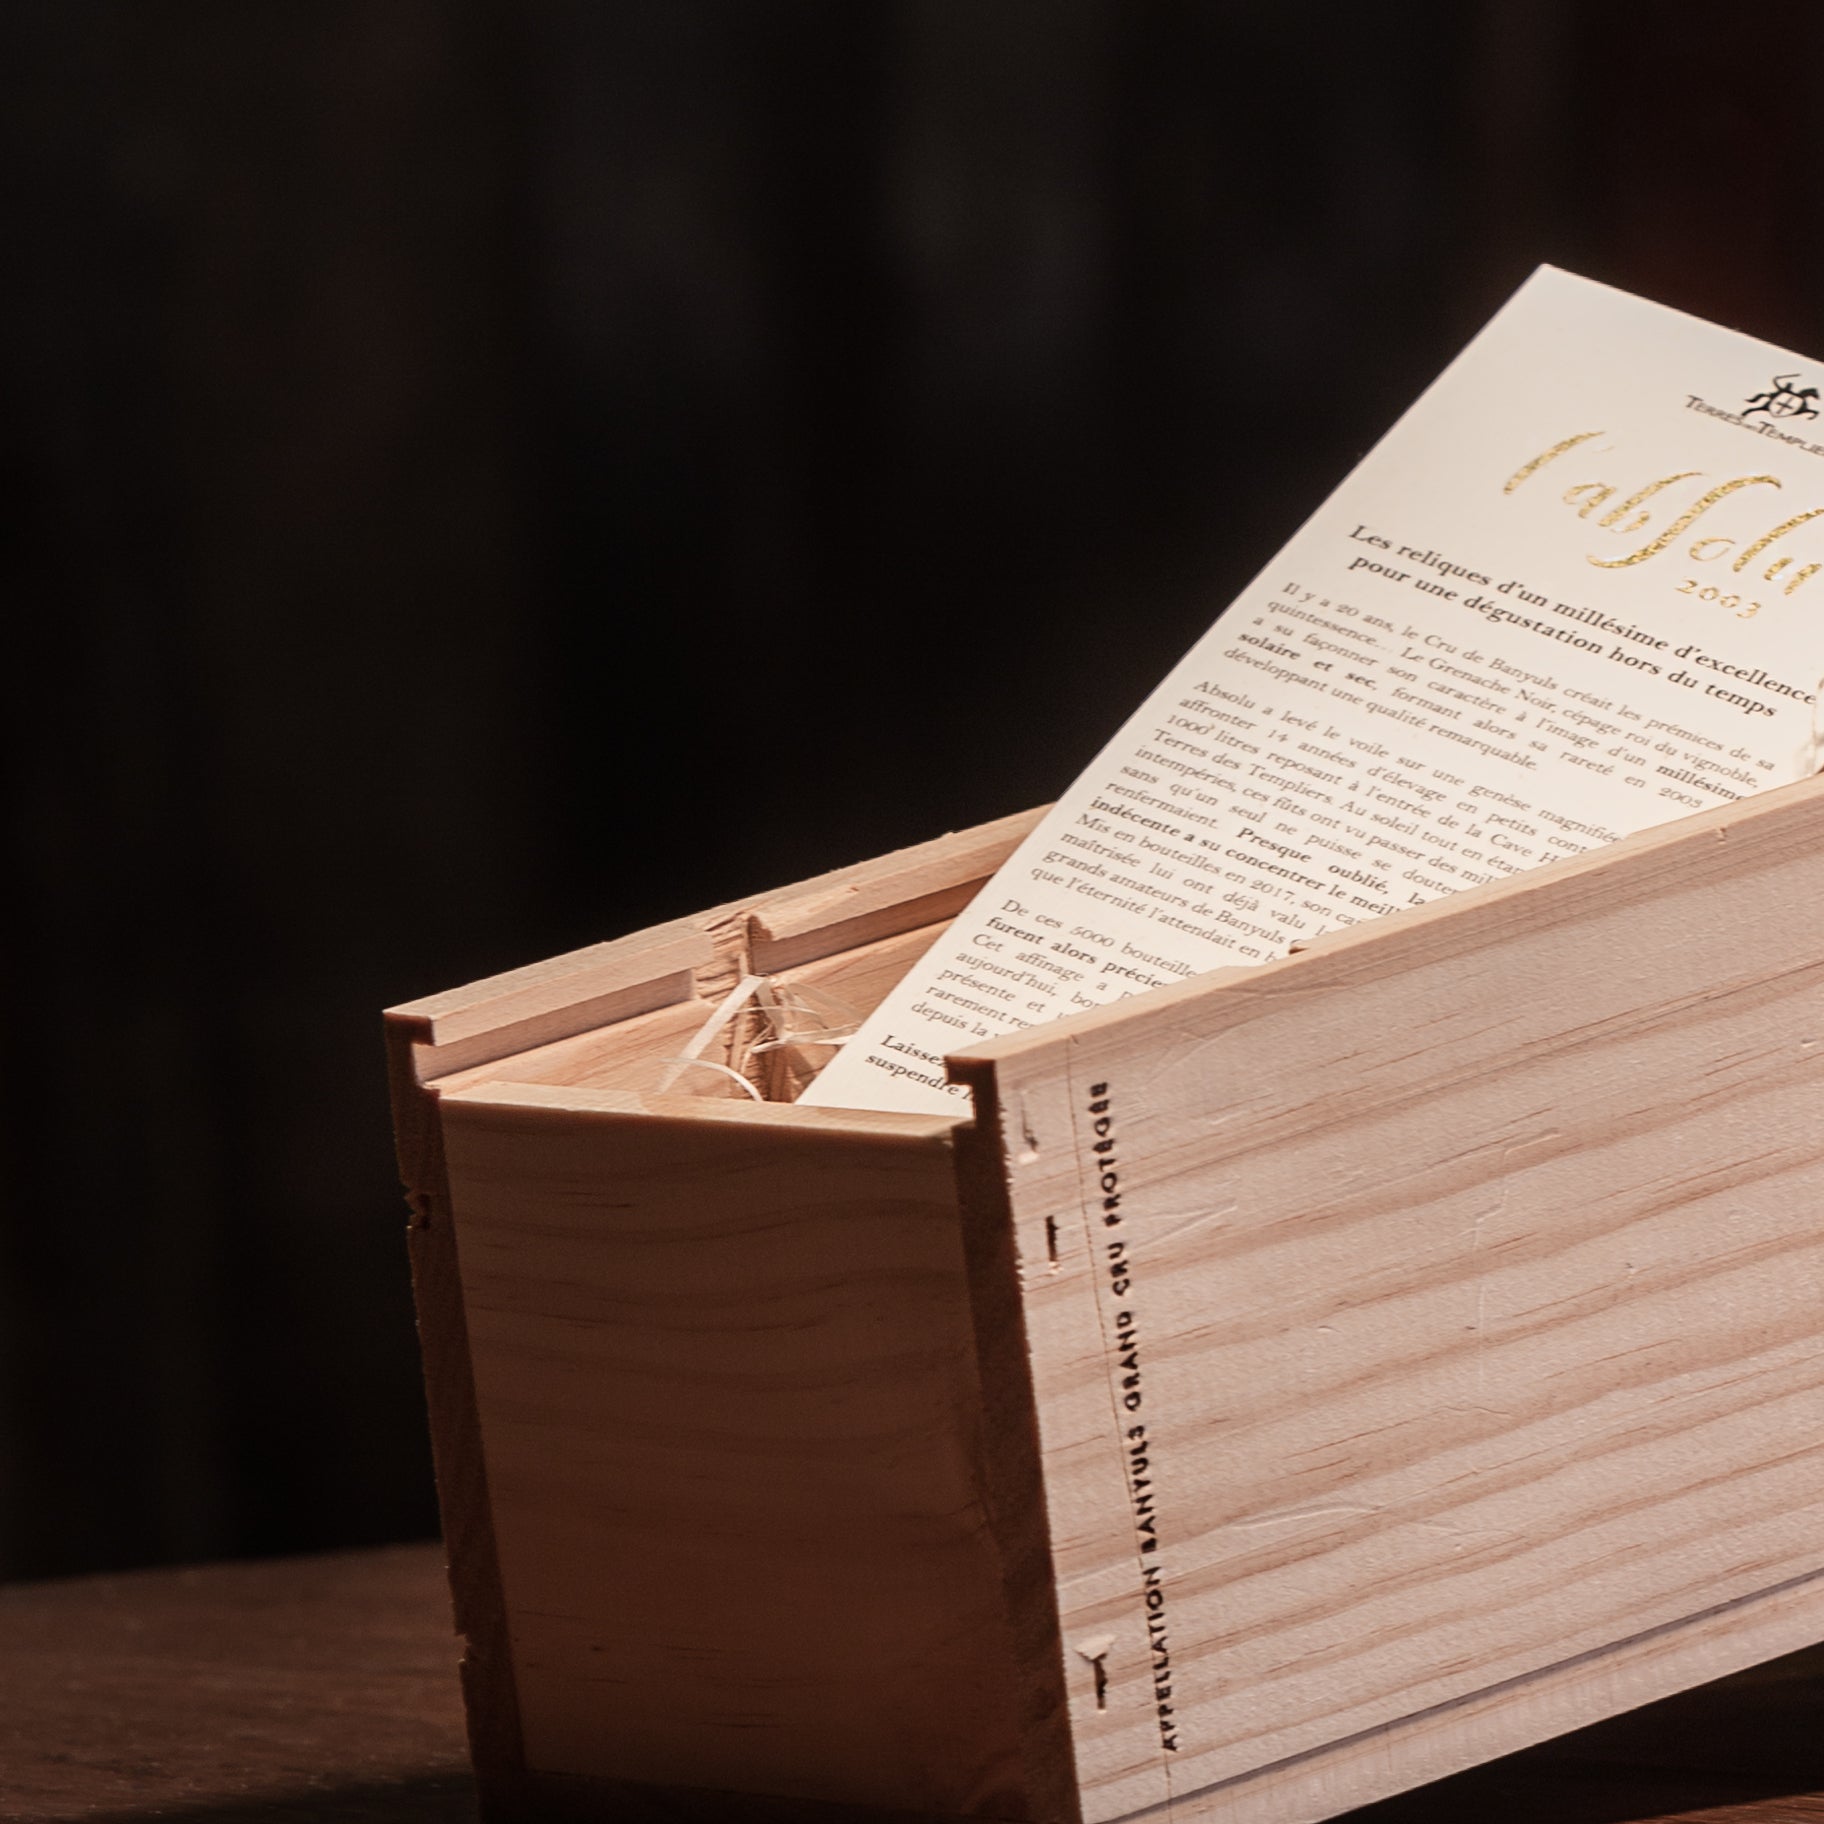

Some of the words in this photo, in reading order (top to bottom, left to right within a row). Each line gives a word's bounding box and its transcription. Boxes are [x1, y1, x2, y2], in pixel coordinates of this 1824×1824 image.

[1685, 394, 1746, 426] TERRES
[1347, 556, 1412, 582] pour
[1414, 579, 1459, 601] une
[1463, 595, 1603, 654] dégustation
[1607, 646, 1660, 675] hors
[1667, 670, 1699, 689] du
[1704, 684, 1777, 717] temps
[1348, 524, 1392, 550] Les
[1396, 546, 1491, 586] reliques
[1496, 580, 1548, 607] d'un
[1552, 603, 1669, 650] millésime
[1673, 645, 1816, 705] d'excellence
[1675, 578, 1763, 620] 2003
[1223, 647, 1329, 692] développant
[1330, 687, 1364, 705] une
[1365, 701, 1428, 728] qualité
[1273, 624, 1294, 637] su
[1301, 632, 1379, 667] façonner
[1386, 666, 1418, 683] son
[1426, 681, 1507, 714] caractère
[1282, 582, 1301, 596] Il
[1335, 604, 1360, 617] 20
[1400, 625, 1420, 640] le
[1423, 634, 1458, 654] Cru
[1461, 649, 1485, 664] de
[1487, 657, 1559, 690] Banyuls
[1562, 688, 1614, 711] créait
[1616, 704, 1642, 721] les
[1643, 719, 1725, 752] prémices
[1729, 747, 1752, 762] de
[1755, 759, 1776, 771] sa
[1400, 646, 1425, 662] Le
[1428, 657, 1511, 695] Grenache
[1561, 709, 1622, 736] cépage
[1623, 732, 1651, 747] roi
[1653, 741, 1678, 756] du
[1178, 698, 1257, 730] affronter
[1267, 729, 1289, 743] 14
[1297, 742, 1358, 768] années
[1455, 801, 1479, 815] en
[1484, 813, 1538, 837] petits
[1192, 680, 1256, 709] Absolu
[1279, 710, 1319, 732] levé
[1322, 725, 1341, 740] le
[1349, 737, 1390, 758] voile
[1395, 756, 1427, 771] sur
[1431, 769, 1465, 786] une
[1467, 785, 1532, 811] genèse
[1237, 633, 1301, 660] solaire
[1312, 661, 1334, 672] et
[1390, 686, 1463, 720] formant
[1472, 719, 1517, 740] alors
[1528, 740, 1549, 752] sa
[1559, 751, 1615, 776] rareté
[1623, 776, 1647, 789] en
[1657, 787, 1704, 809] 2003
[1119, 765, 1160, 784] sans
[1228, 805, 1268, 824] seul
[1274, 822, 1298, 836] ne
[1303, 834, 1363, 860] puisse
[1371, 859, 1392, 871] se
[1153, 728, 1209, 758] Terres
[1211, 752, 1242, 770] des
[1338, 800, 1368, 817] Au
[1369, 813, 1420, 836] soleil
[1420, 831, 1459, 852] tout
[1460, 848, 1484, 861] en
[1213, 729, 1260, 755] litres
[1266, 752, 1343, 785] reposant
[1437, 814, 1460, 829] de
[1464, 823, 1483, 838] la
[1489, 833, 1533, 857] Cave
[1241, 787, 1271, 803] ces
[1271, 796, 1308, 817] fûts
[1309, 813, 1342, 830] ont
[1345, 825, 1367, 839] vu
[1365, 835, 1427, 860] passer
[1427, 855, 1459, 874] des
[1030, 868, 1065, 885] que
[1059, 833, 1141, 868] maîtrisée
[1148, 861, 1174, 880] lui
[1182, 878, 1215, 895] ont
[1222, 891, 1260, 912] déjà
[1270, 909, 1307, 930] valu
[1075, 813, 1111, 834] Mis
[1113, 830, 1136, 844] en
[1138, 835, 1222, 875] bouteilles
[1224, 871, 1247, 885] en
[1300, 900, 1333, 917] son
[1089, 795, 1181, 837] indécente
[1198, 839, 1222, 852] su
[1224, 848, 1326, 890] concentrer
[1327, 884, 1347, 899] le
[1236, 827, 1312, 863] Presque
[985, 916, 1045, 945] furent
[1050, 942, 1097, 965] alors
[1034, 914, 1064, 929] ces
[1069, 926, 1116, 948] 5000
[1041, 850, 1109, 878] grands
[1108, 873, 1190, 908] amateurs
[1191, 902, 1214, 917] de
[1213, 909, 1286, 945] Banyuls
[925, 986, 1008, 1022] rarement
[935, 969, 1017, 1002] présente
[972, 933, 1004, 953] Cet
[1014, 952, 1085, 982] affinage
[910, 1001, 969, 1029] depuis
[868, 1055, 961, 1095] suspendre
[1107, 1241, 1131, 1297] CRU
[1116, 1310, 1142, 1413] GRAND
[1126, 1424, 1158, 1555] BANYULS
[1142, 1565, 1178, 1753] APPELLATION
